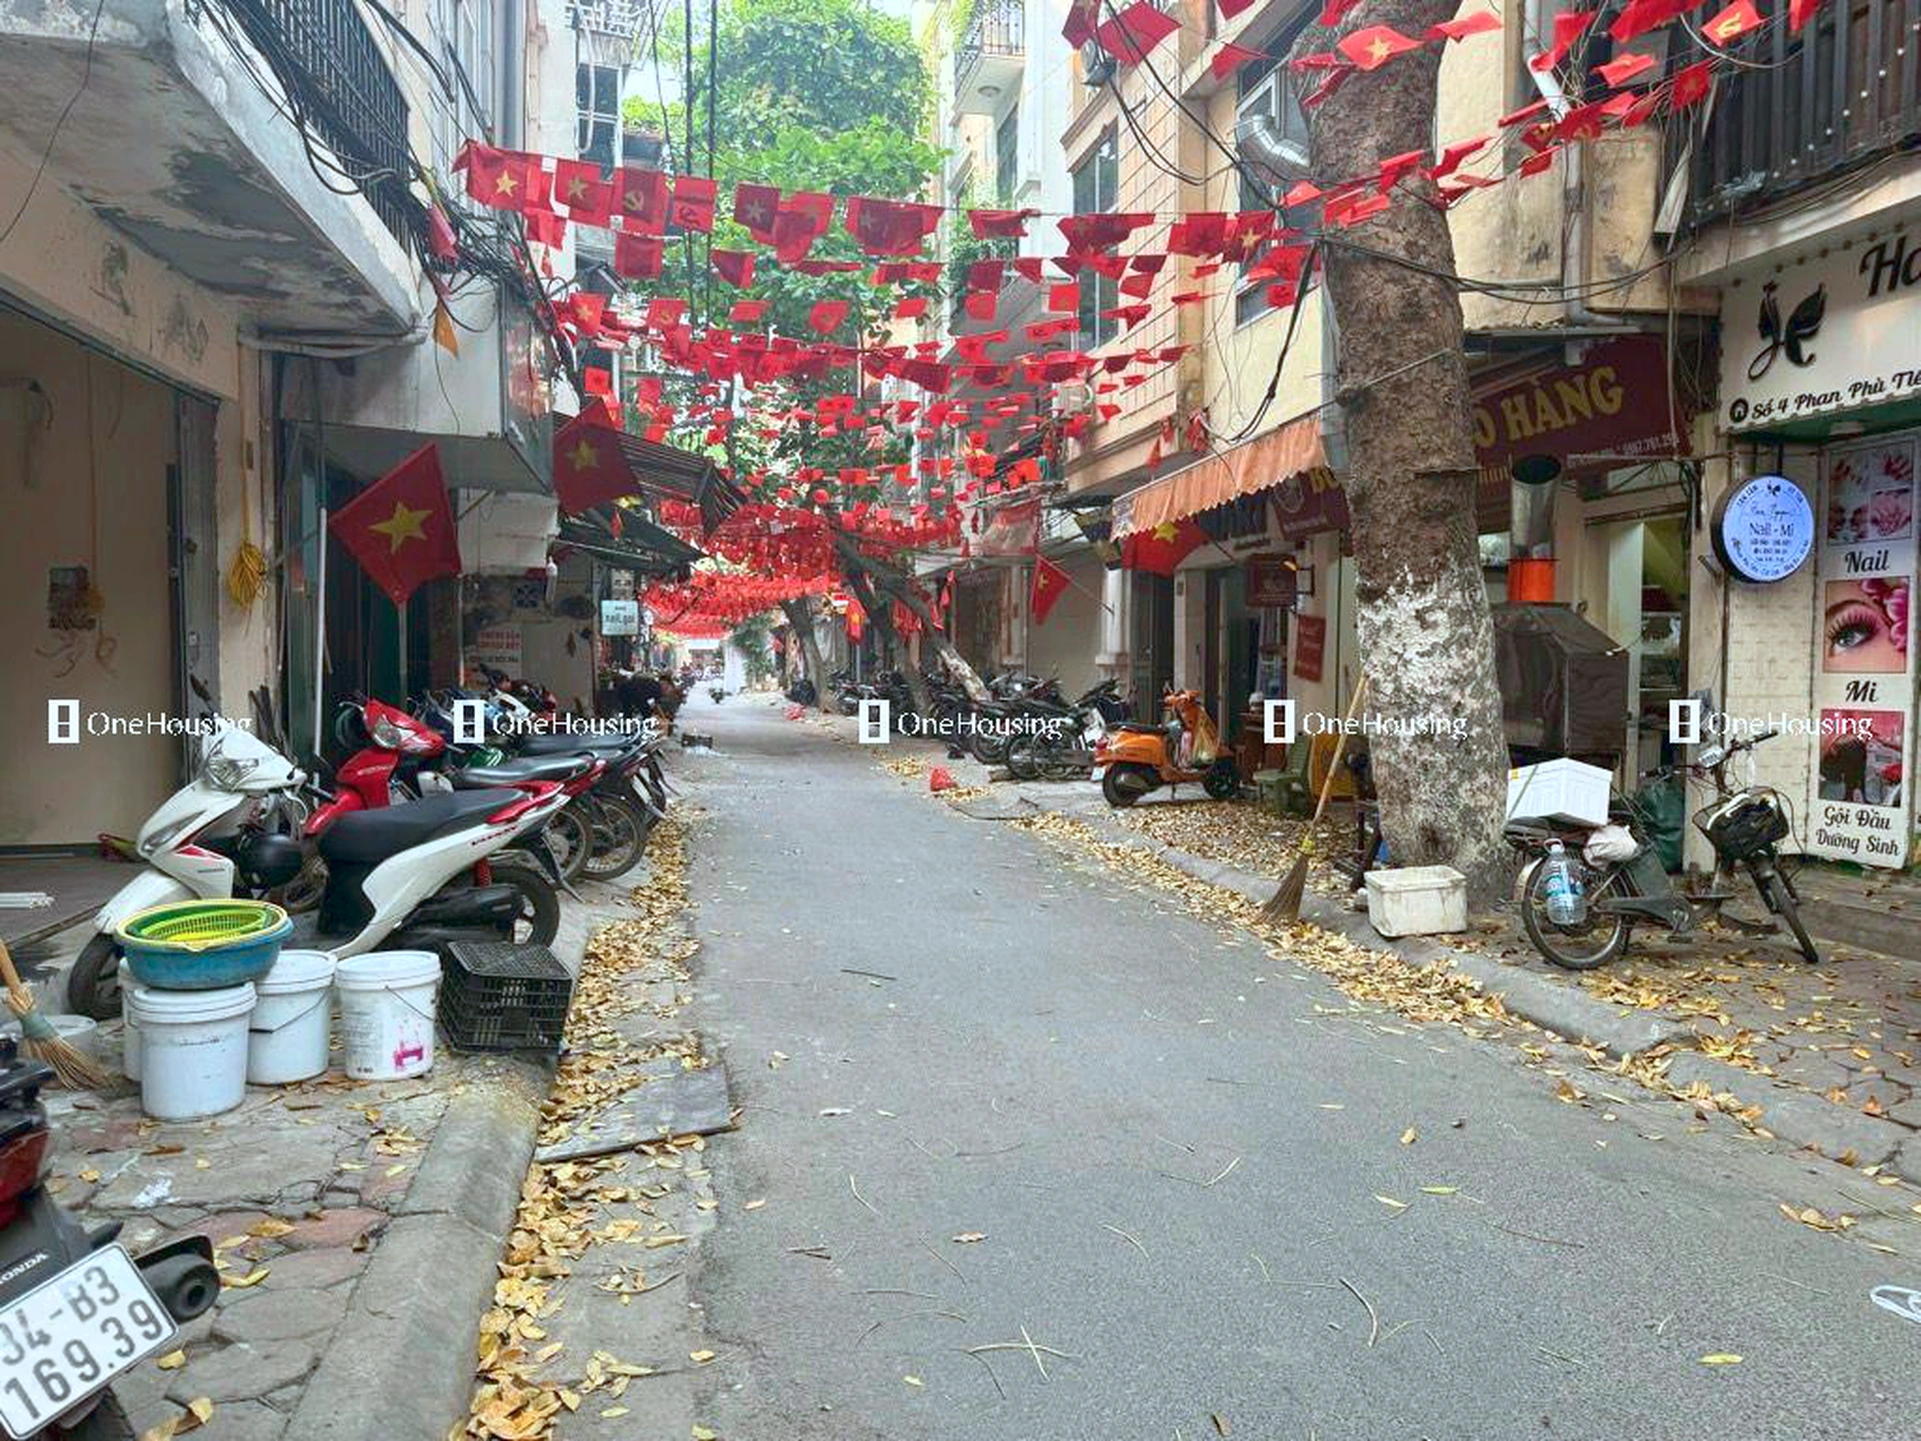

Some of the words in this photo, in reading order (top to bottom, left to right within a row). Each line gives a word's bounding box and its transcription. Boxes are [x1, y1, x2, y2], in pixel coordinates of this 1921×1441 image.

[1500, 365, 1624, 442] HÀNG
[1751, 400, 1775, 420] Số
[1777, 398, 1789, 414] 4
[1794, 388, 1842, 410] Phan
[1845, 549, 1890, 574] Nail
[1845, 680, 1878, 703] Mi
[1823, 805, 1852, 828] Gội
[1855, 808, 1892, 831] Đầu
[1866, 834, 1901, 857] Sinh
[0, 1252, 49, 1285] ONDA
[4, 1298, 164, 1420] 169.39
